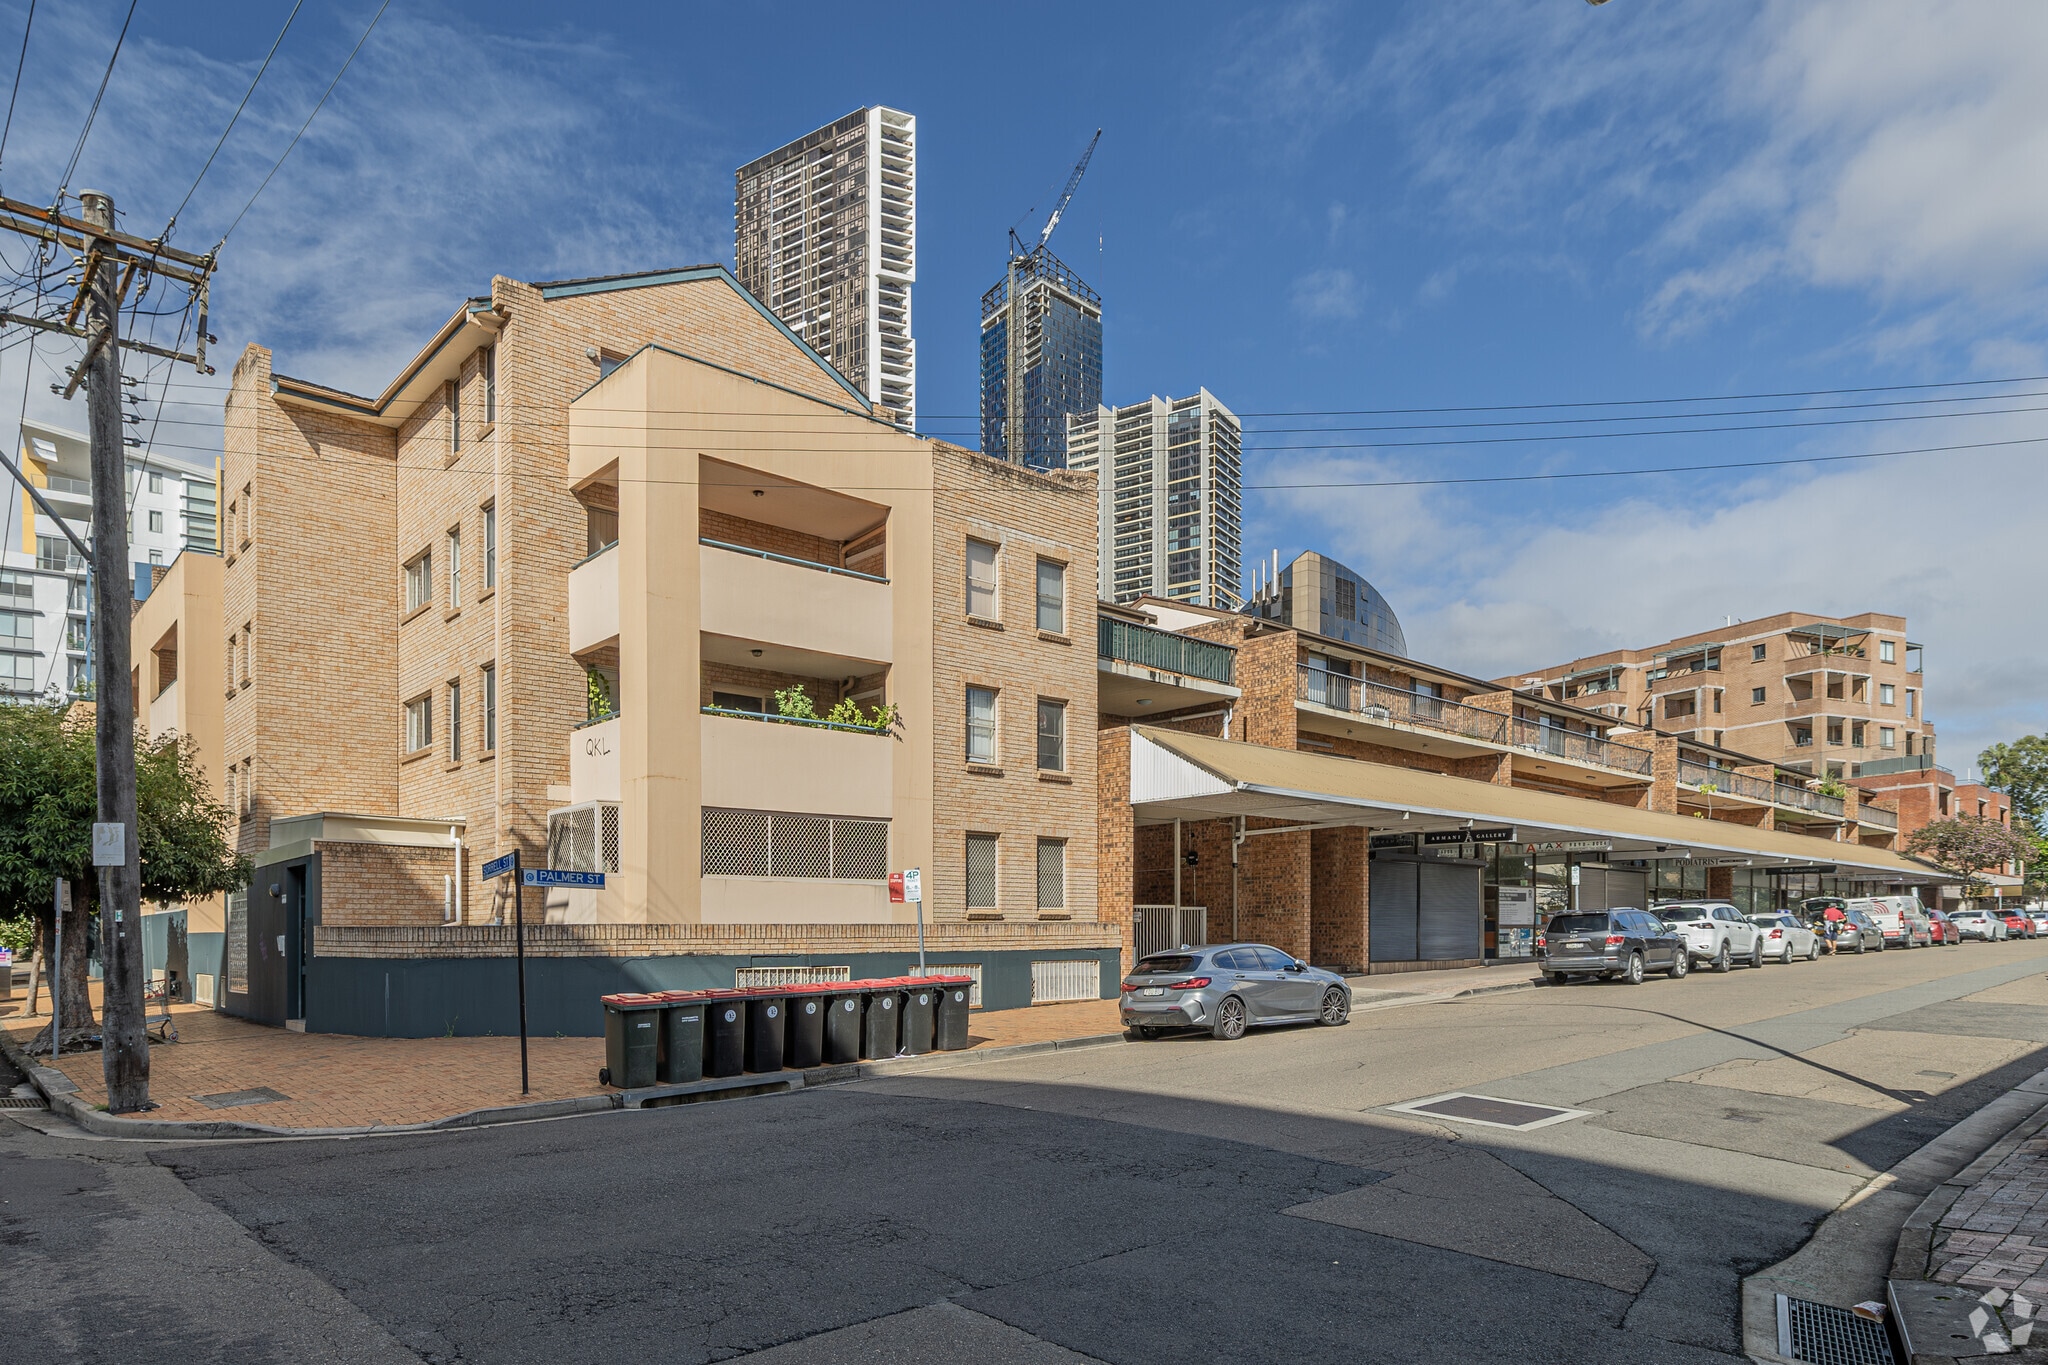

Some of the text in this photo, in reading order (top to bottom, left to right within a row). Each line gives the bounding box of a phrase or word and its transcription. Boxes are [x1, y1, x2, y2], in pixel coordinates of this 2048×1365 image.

[586, 737, 611, 757] QKL
[1675, 858, 1720, 867] PODIATRIST
[540, 871, 601, 884] PALMER ST
[906, 871, 919, 879] 4P
